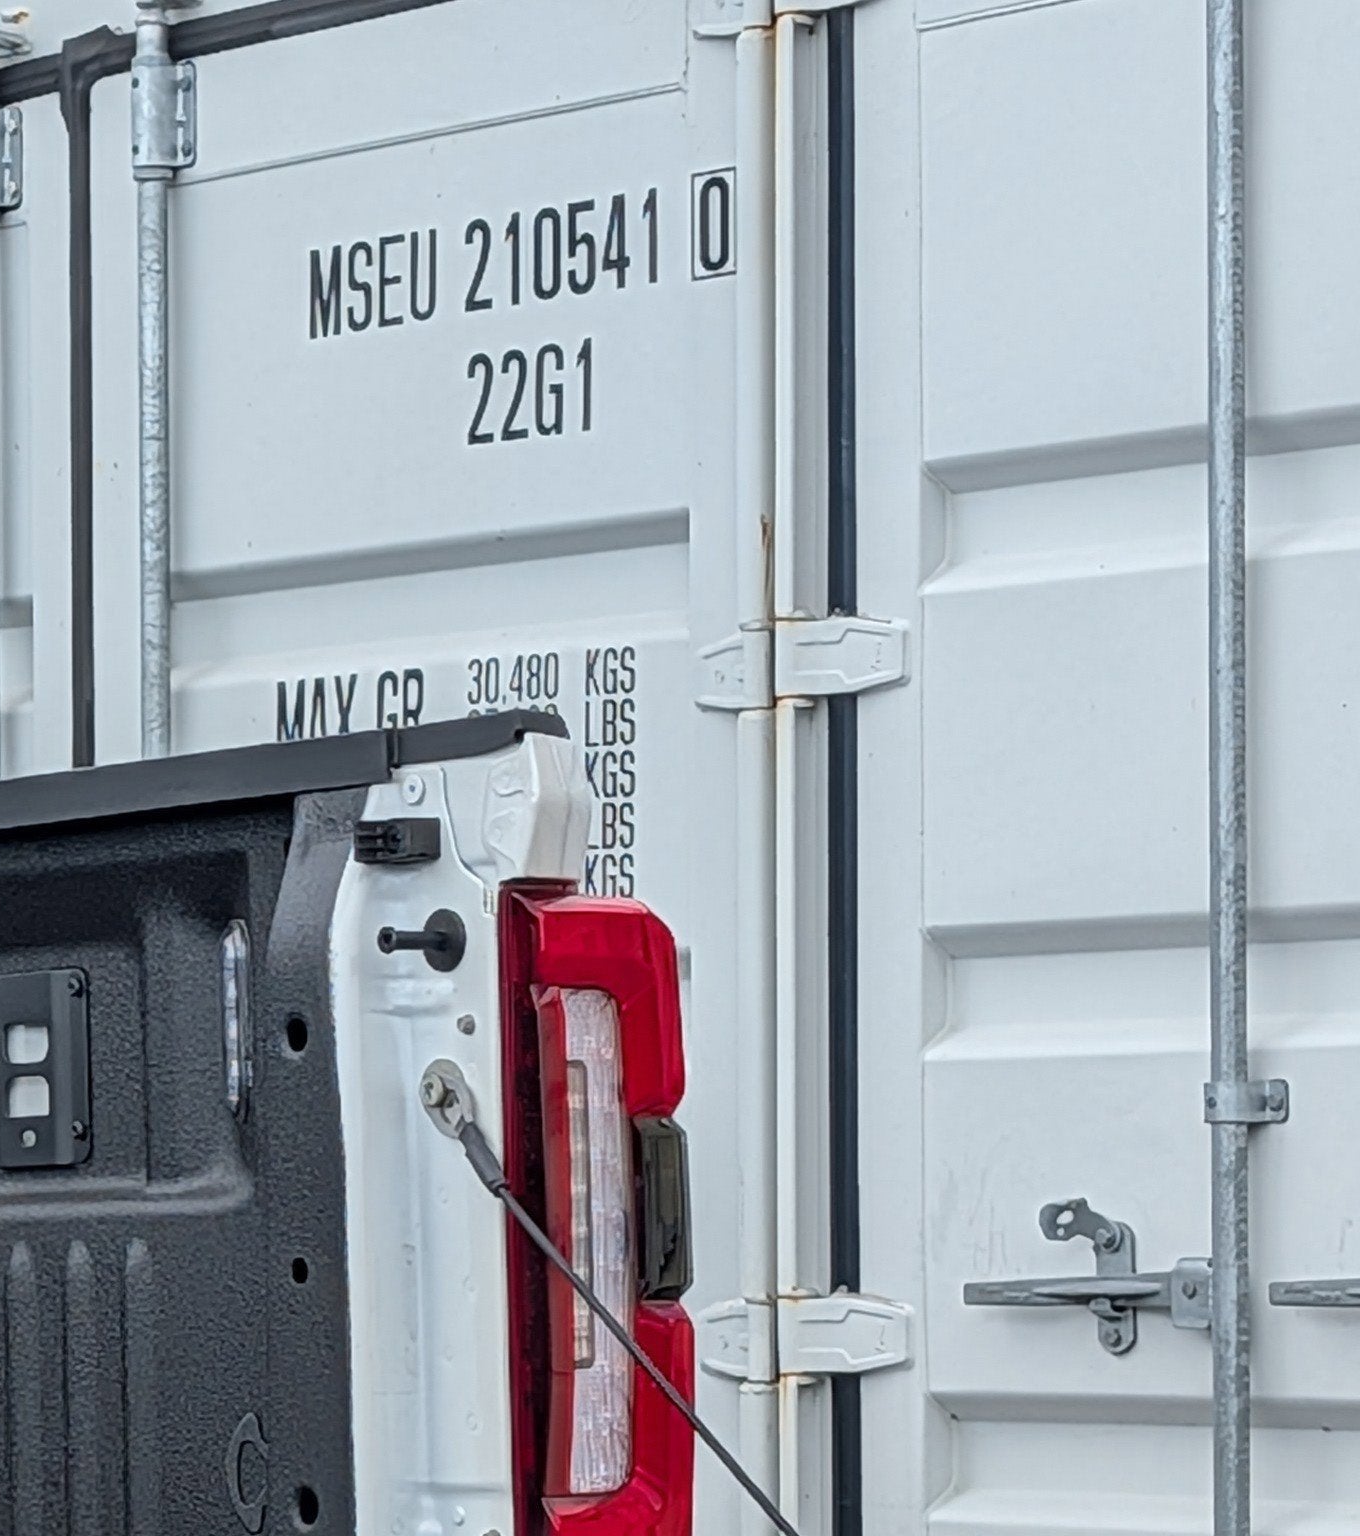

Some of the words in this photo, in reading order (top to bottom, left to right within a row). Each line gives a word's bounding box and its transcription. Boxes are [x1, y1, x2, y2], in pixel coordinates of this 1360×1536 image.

[309, 228, 437, 340] MSEU
[464, 187, 658, 313] 210541
[699, 176, 730, 272] 0
[467, 337, 593, 446] 22G1
[277, 673, 358, 742] MAX
[584, 645, 636, 697] KGS
[584, 697, 636, 748] LBS
[584, 749, 636, 800] KGS
[584, 852, 635, 899] KGS
